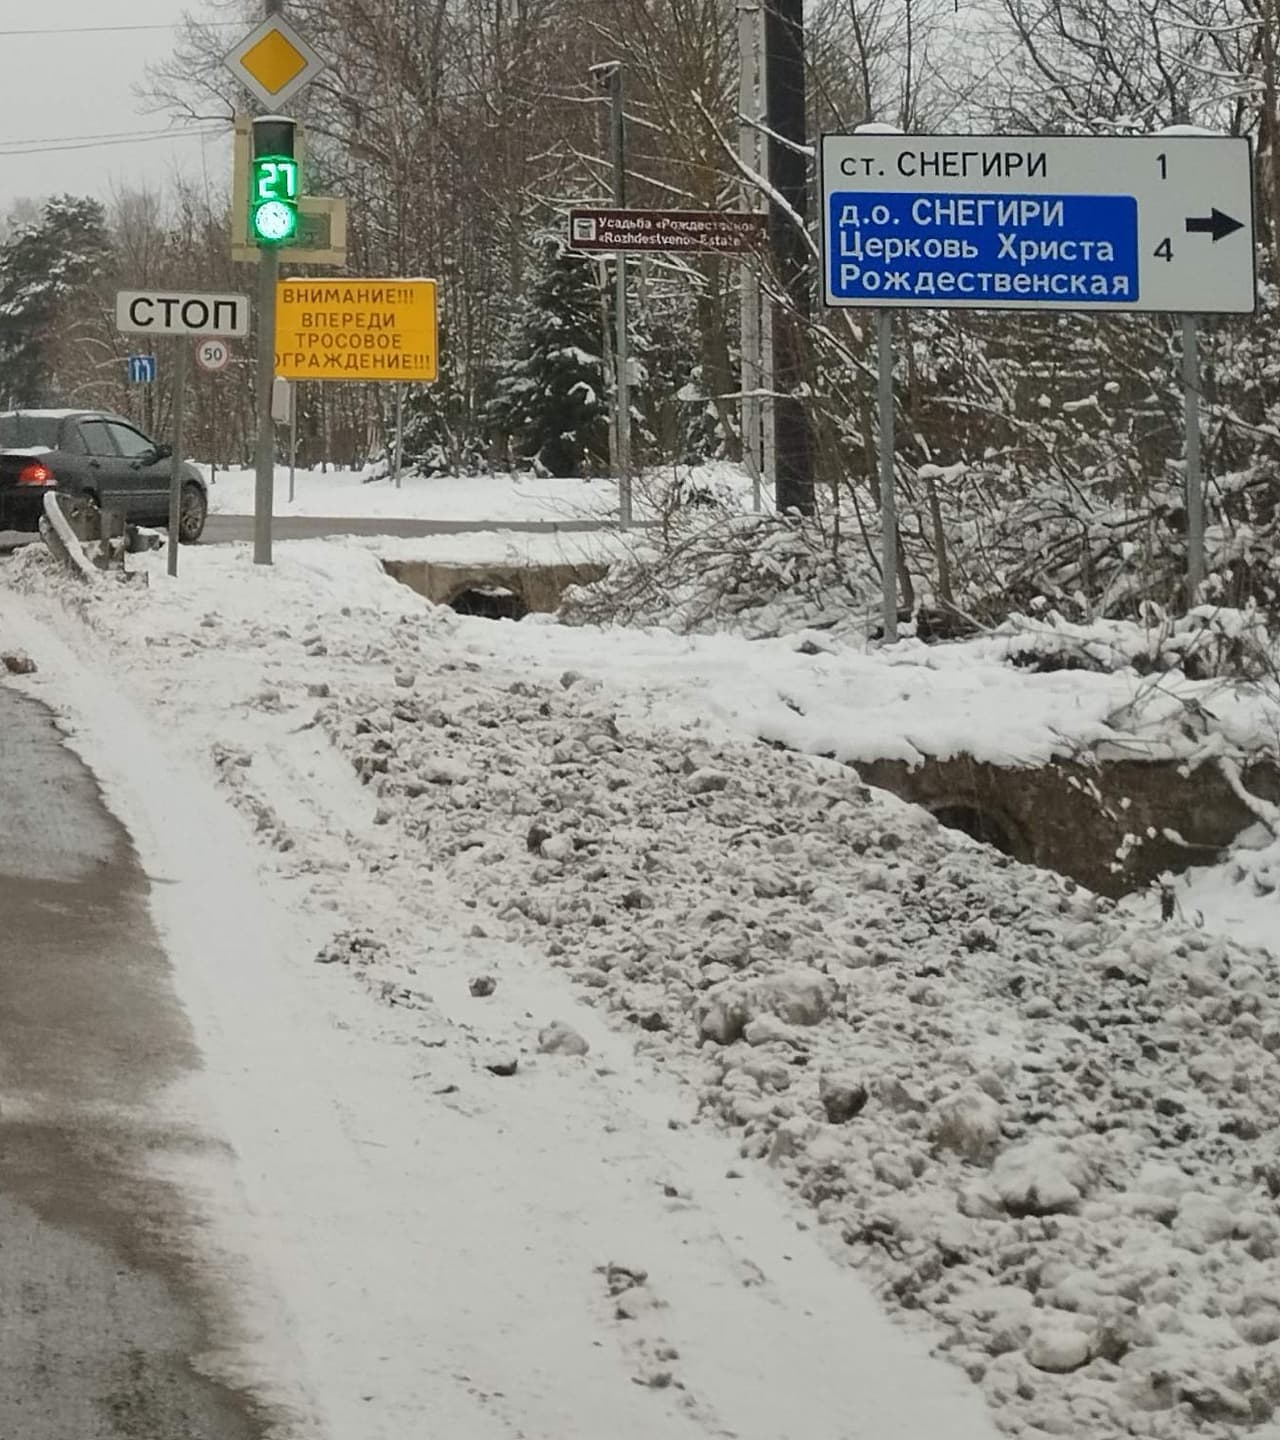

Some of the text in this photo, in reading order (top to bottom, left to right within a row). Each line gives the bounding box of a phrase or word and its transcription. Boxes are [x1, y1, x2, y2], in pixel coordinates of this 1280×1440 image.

[840, 151, 1167, 179] ст. СНЕГИРИ 1
[258, 162, 296, 199] 27
[598, 216, 652, 231] Усадьба
[839, 198, 1065, 228] д.о. СНЕГИРИ
[840, 230, 1174, 266] Церковь Христа 4
[840, 264, 1129, 296] Рождественская
[283, 288, 414, 304] ВНИМАНИЕ!!!
[129, 297, 237, 330] СТОП
[301, 312, 396, 331] ВПЕРЕДИ
[204, 347, 223, 361] 50
[295, 333, 402, 349] ТРОСОВОЕ
